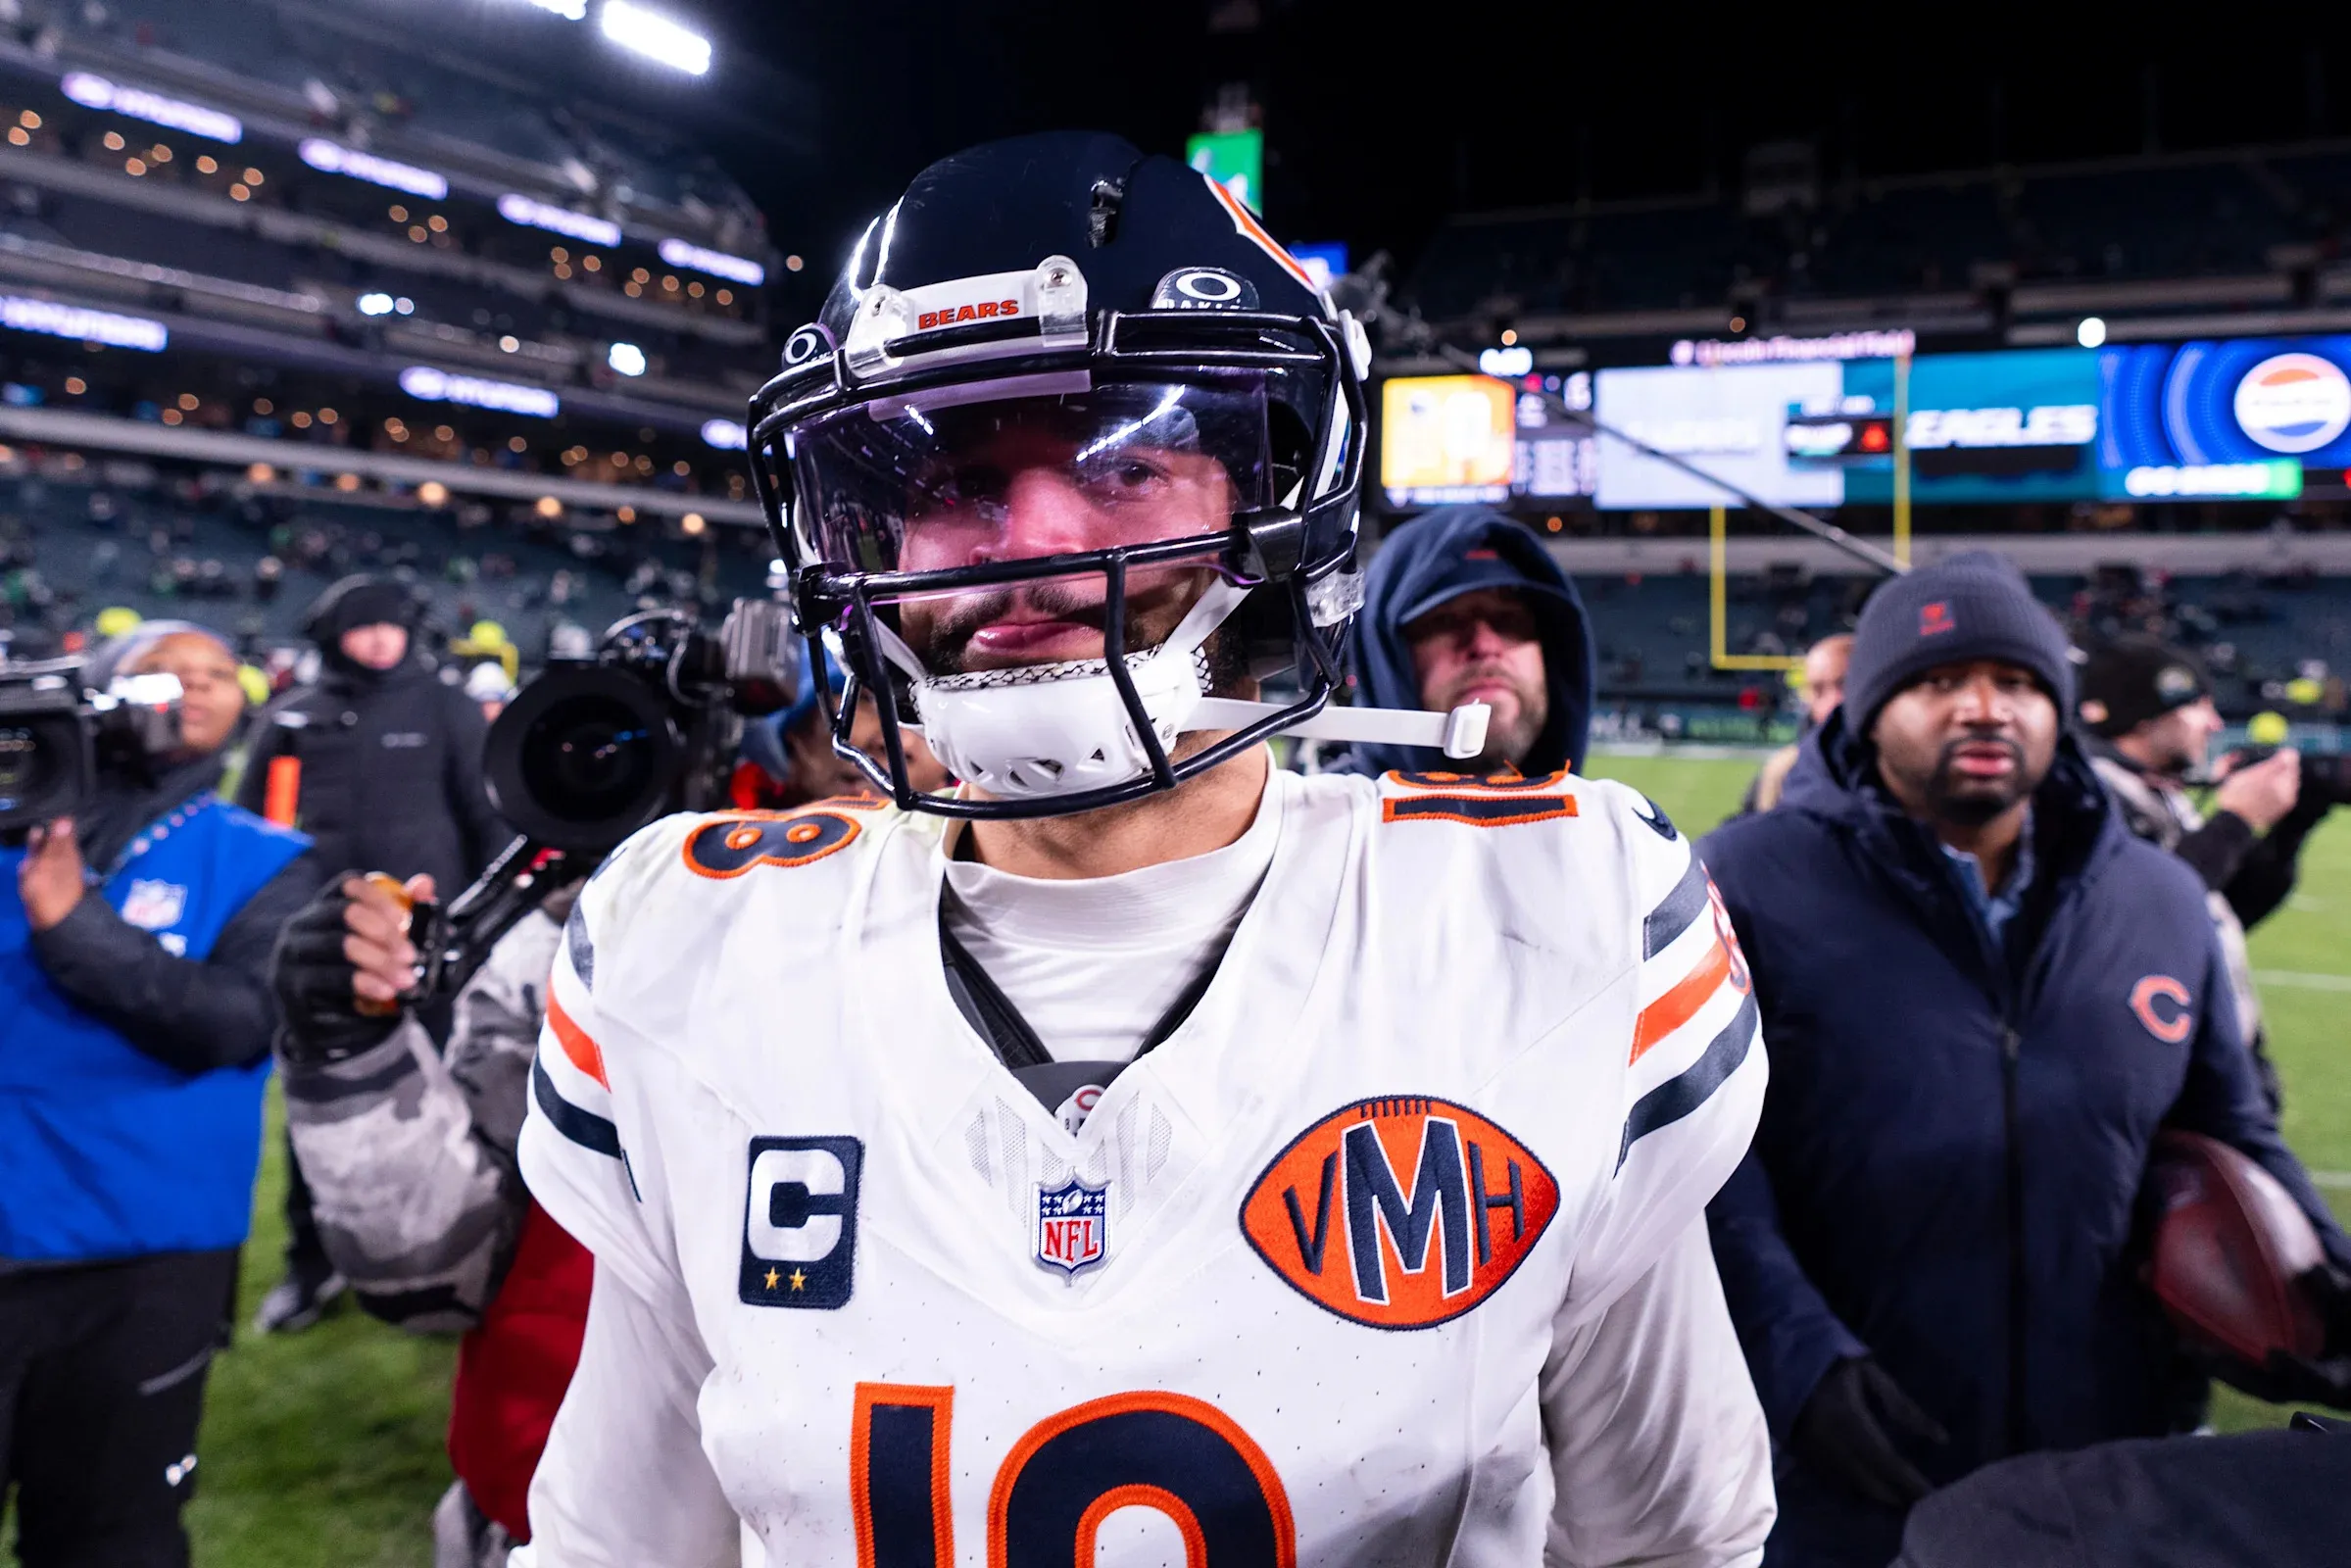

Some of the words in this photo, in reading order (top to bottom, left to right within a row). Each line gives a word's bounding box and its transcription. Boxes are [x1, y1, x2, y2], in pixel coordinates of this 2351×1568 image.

[918, 299, 1019, 330] BEARS
[1904, 404, 2097, 449] EAGLES
[2129, 975, 2191, 1044] C
[747, 1149, 846, 1262] C
[1282, 1114, 1526, 1305] VMH
[1044, 1219, 1099, 1271] NFL
